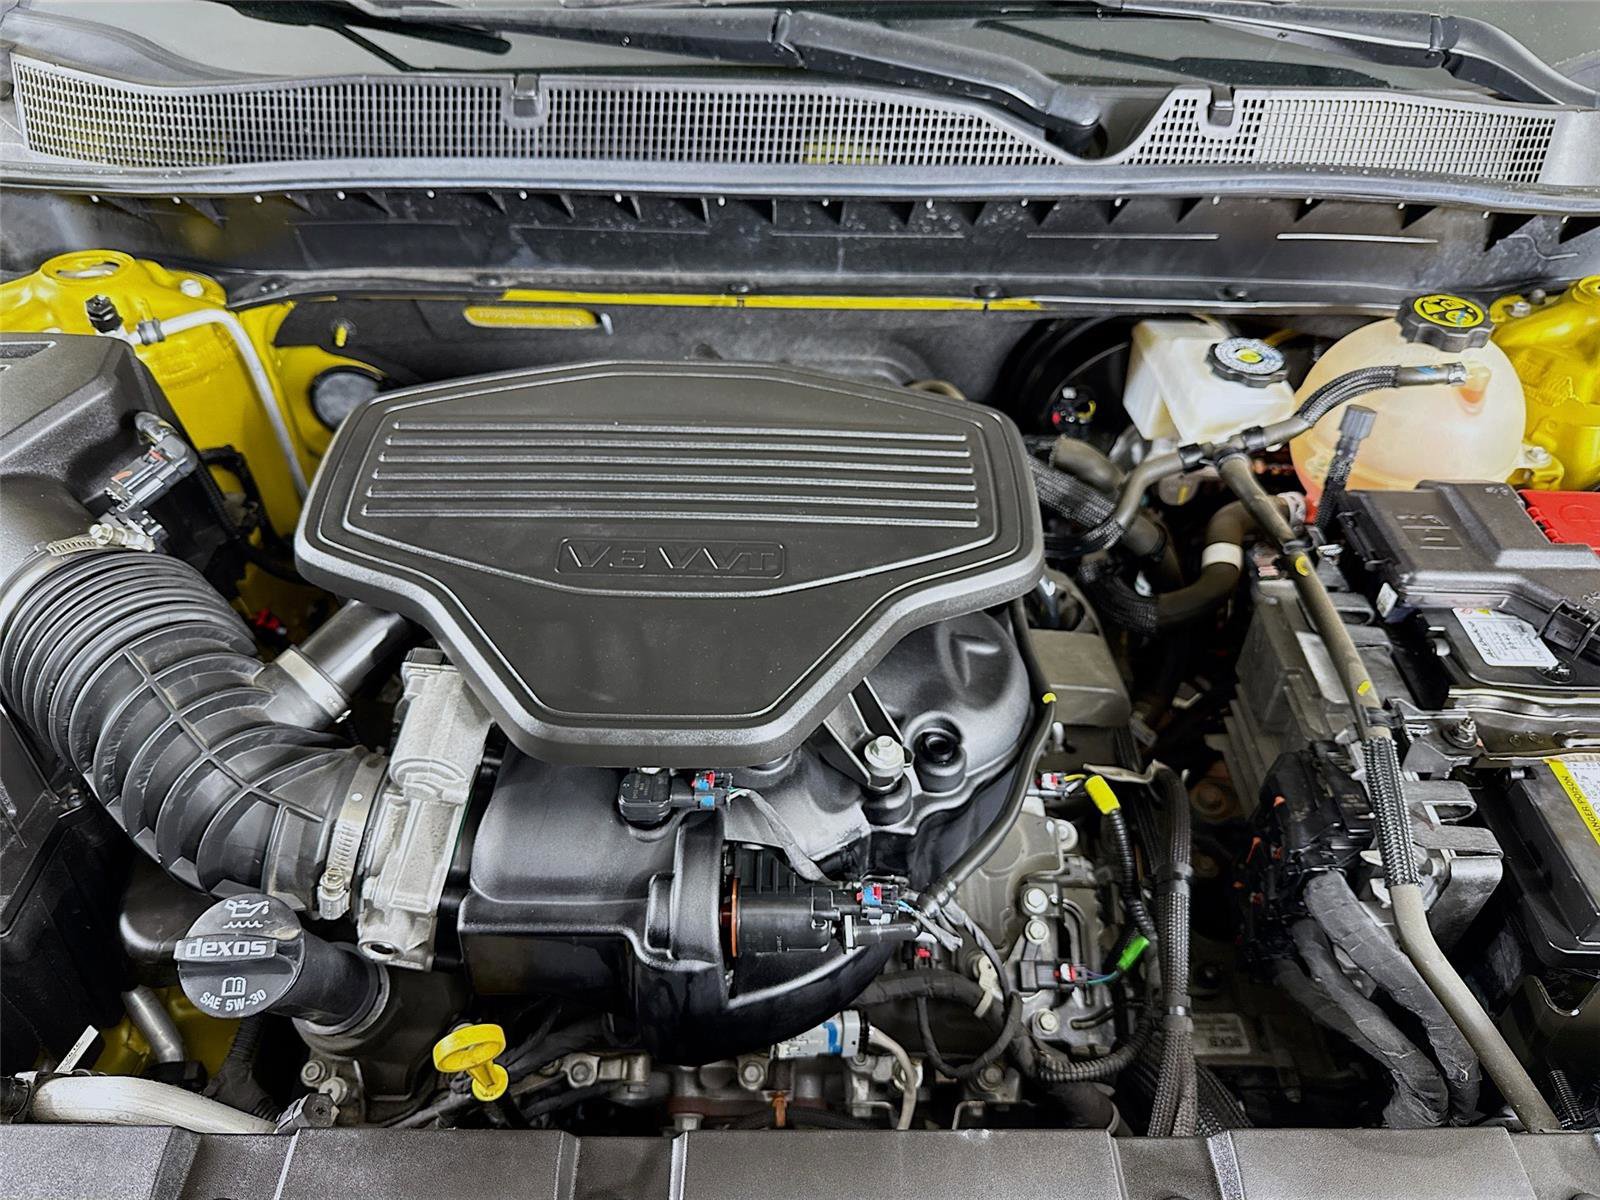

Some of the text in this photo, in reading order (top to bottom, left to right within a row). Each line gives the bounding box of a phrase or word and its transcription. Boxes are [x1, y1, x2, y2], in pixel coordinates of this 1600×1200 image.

[658, 546, 777, 571] VVT
[1562, 775, 1585, 805] POISON
[1582, 805, 1600, 838] ANGER
[184, 938, 268, 958] dexos
[200, 989, 267, 1012] SAE 5W-30
